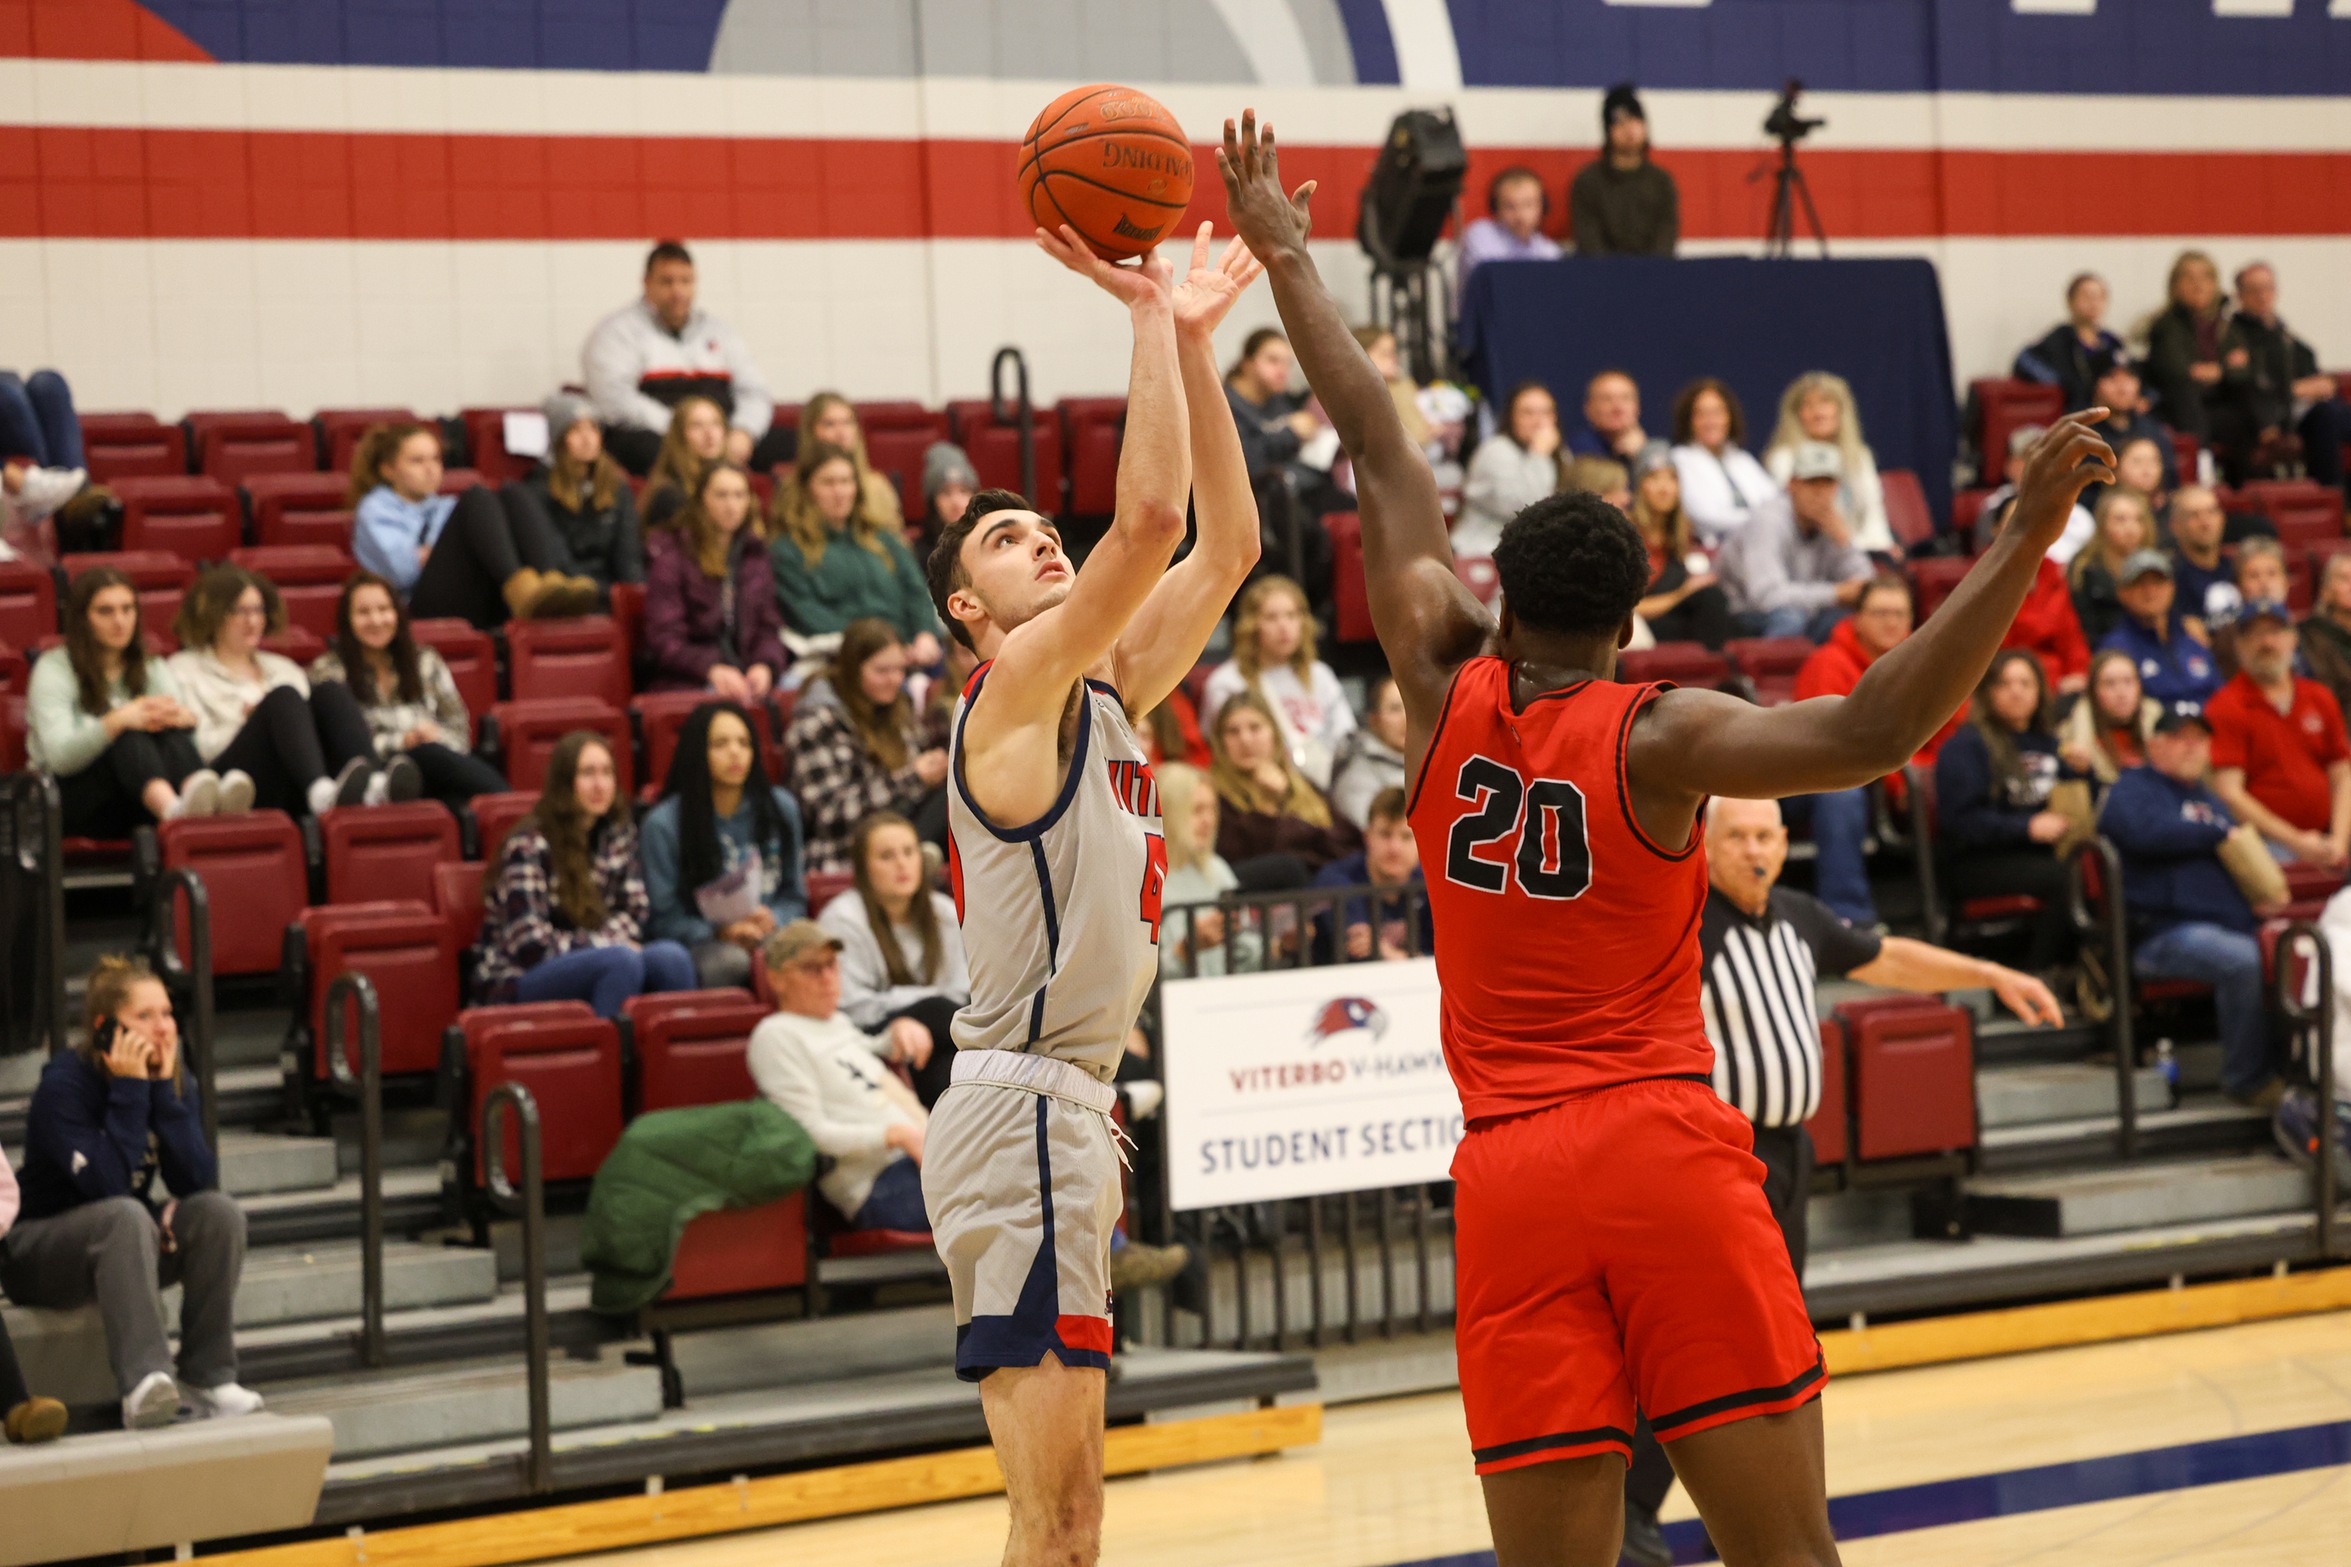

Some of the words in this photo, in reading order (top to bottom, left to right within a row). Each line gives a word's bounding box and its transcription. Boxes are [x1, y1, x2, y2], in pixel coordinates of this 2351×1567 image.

[1104, 757, 1163, 818] VIT
[1446, 754, 1592, 900] 20
[1230, 1059, 1345, 1092] VITERBO
[1201, 1127, 1349, 1173] STUDENT
